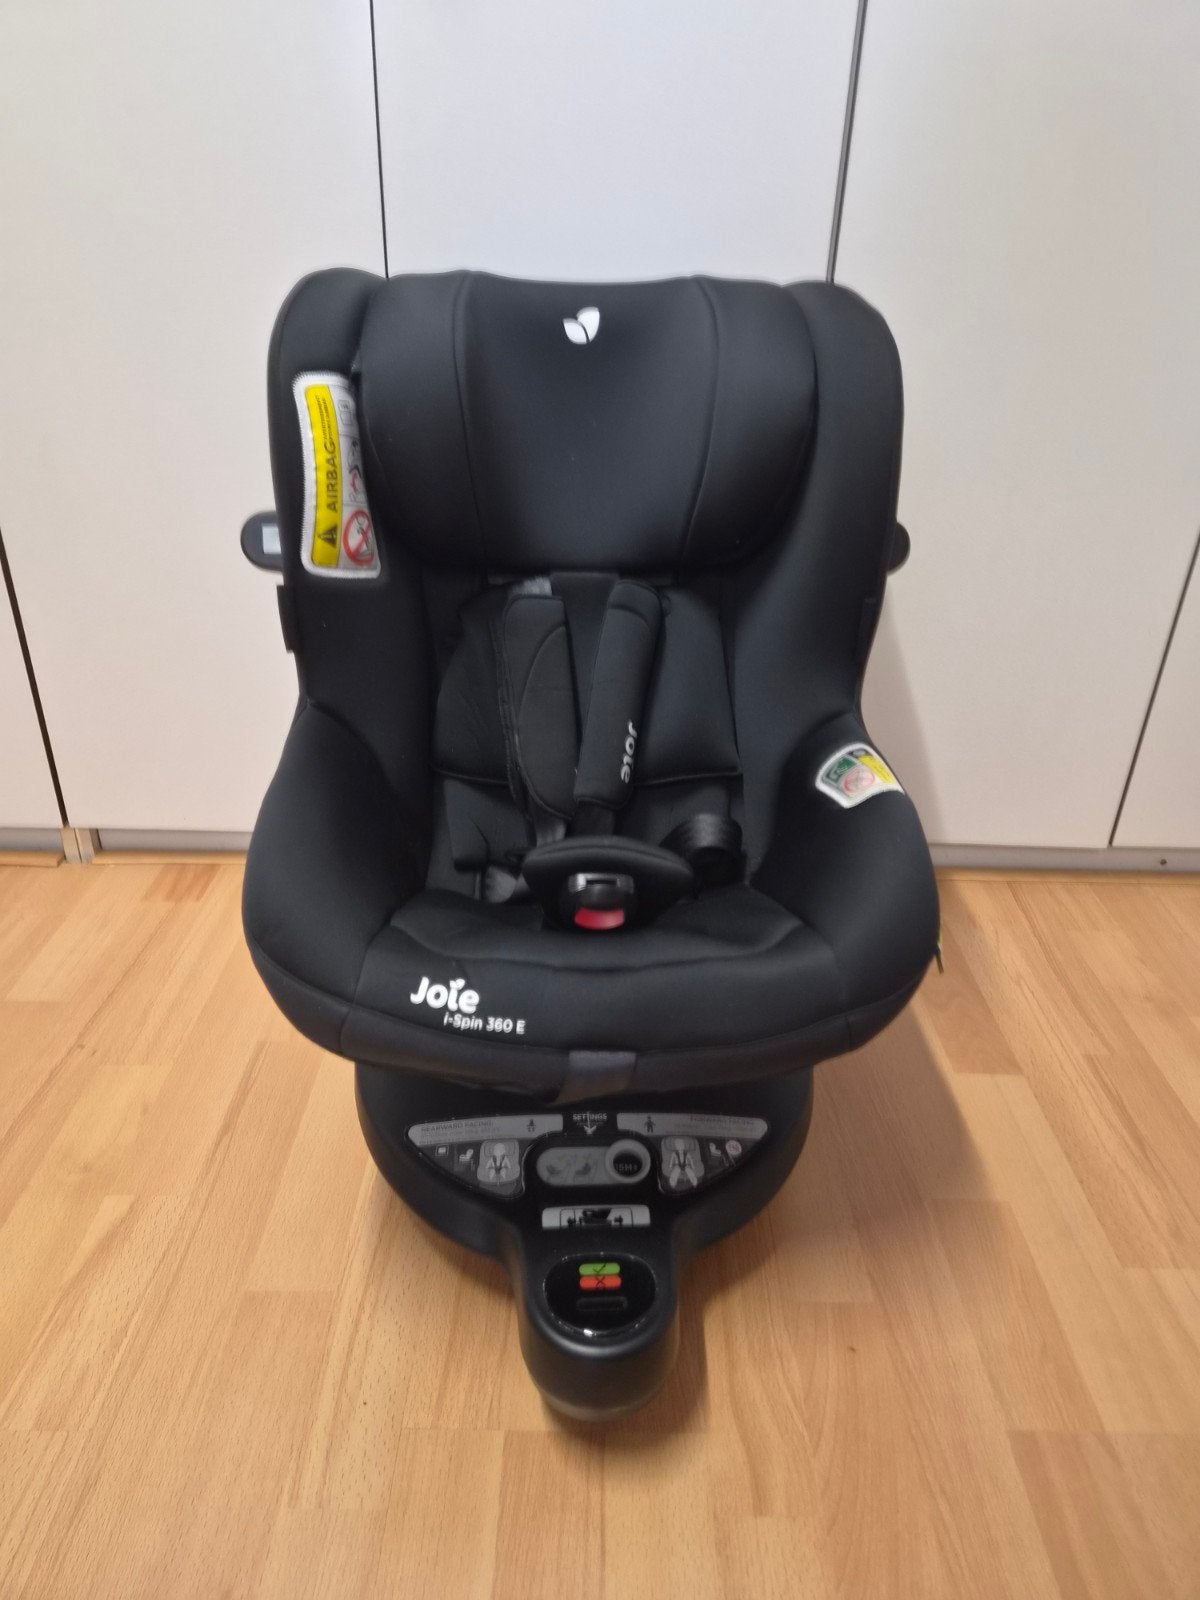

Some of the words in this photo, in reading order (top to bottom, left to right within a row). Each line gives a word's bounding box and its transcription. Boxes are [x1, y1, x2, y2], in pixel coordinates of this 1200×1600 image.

[324, 441, 338, 513] AIRBAG
[410, 976, 480, 1014] Joie
[486, 1016, 514, 1033] 360
[516, 1019, 526, 1035] E
